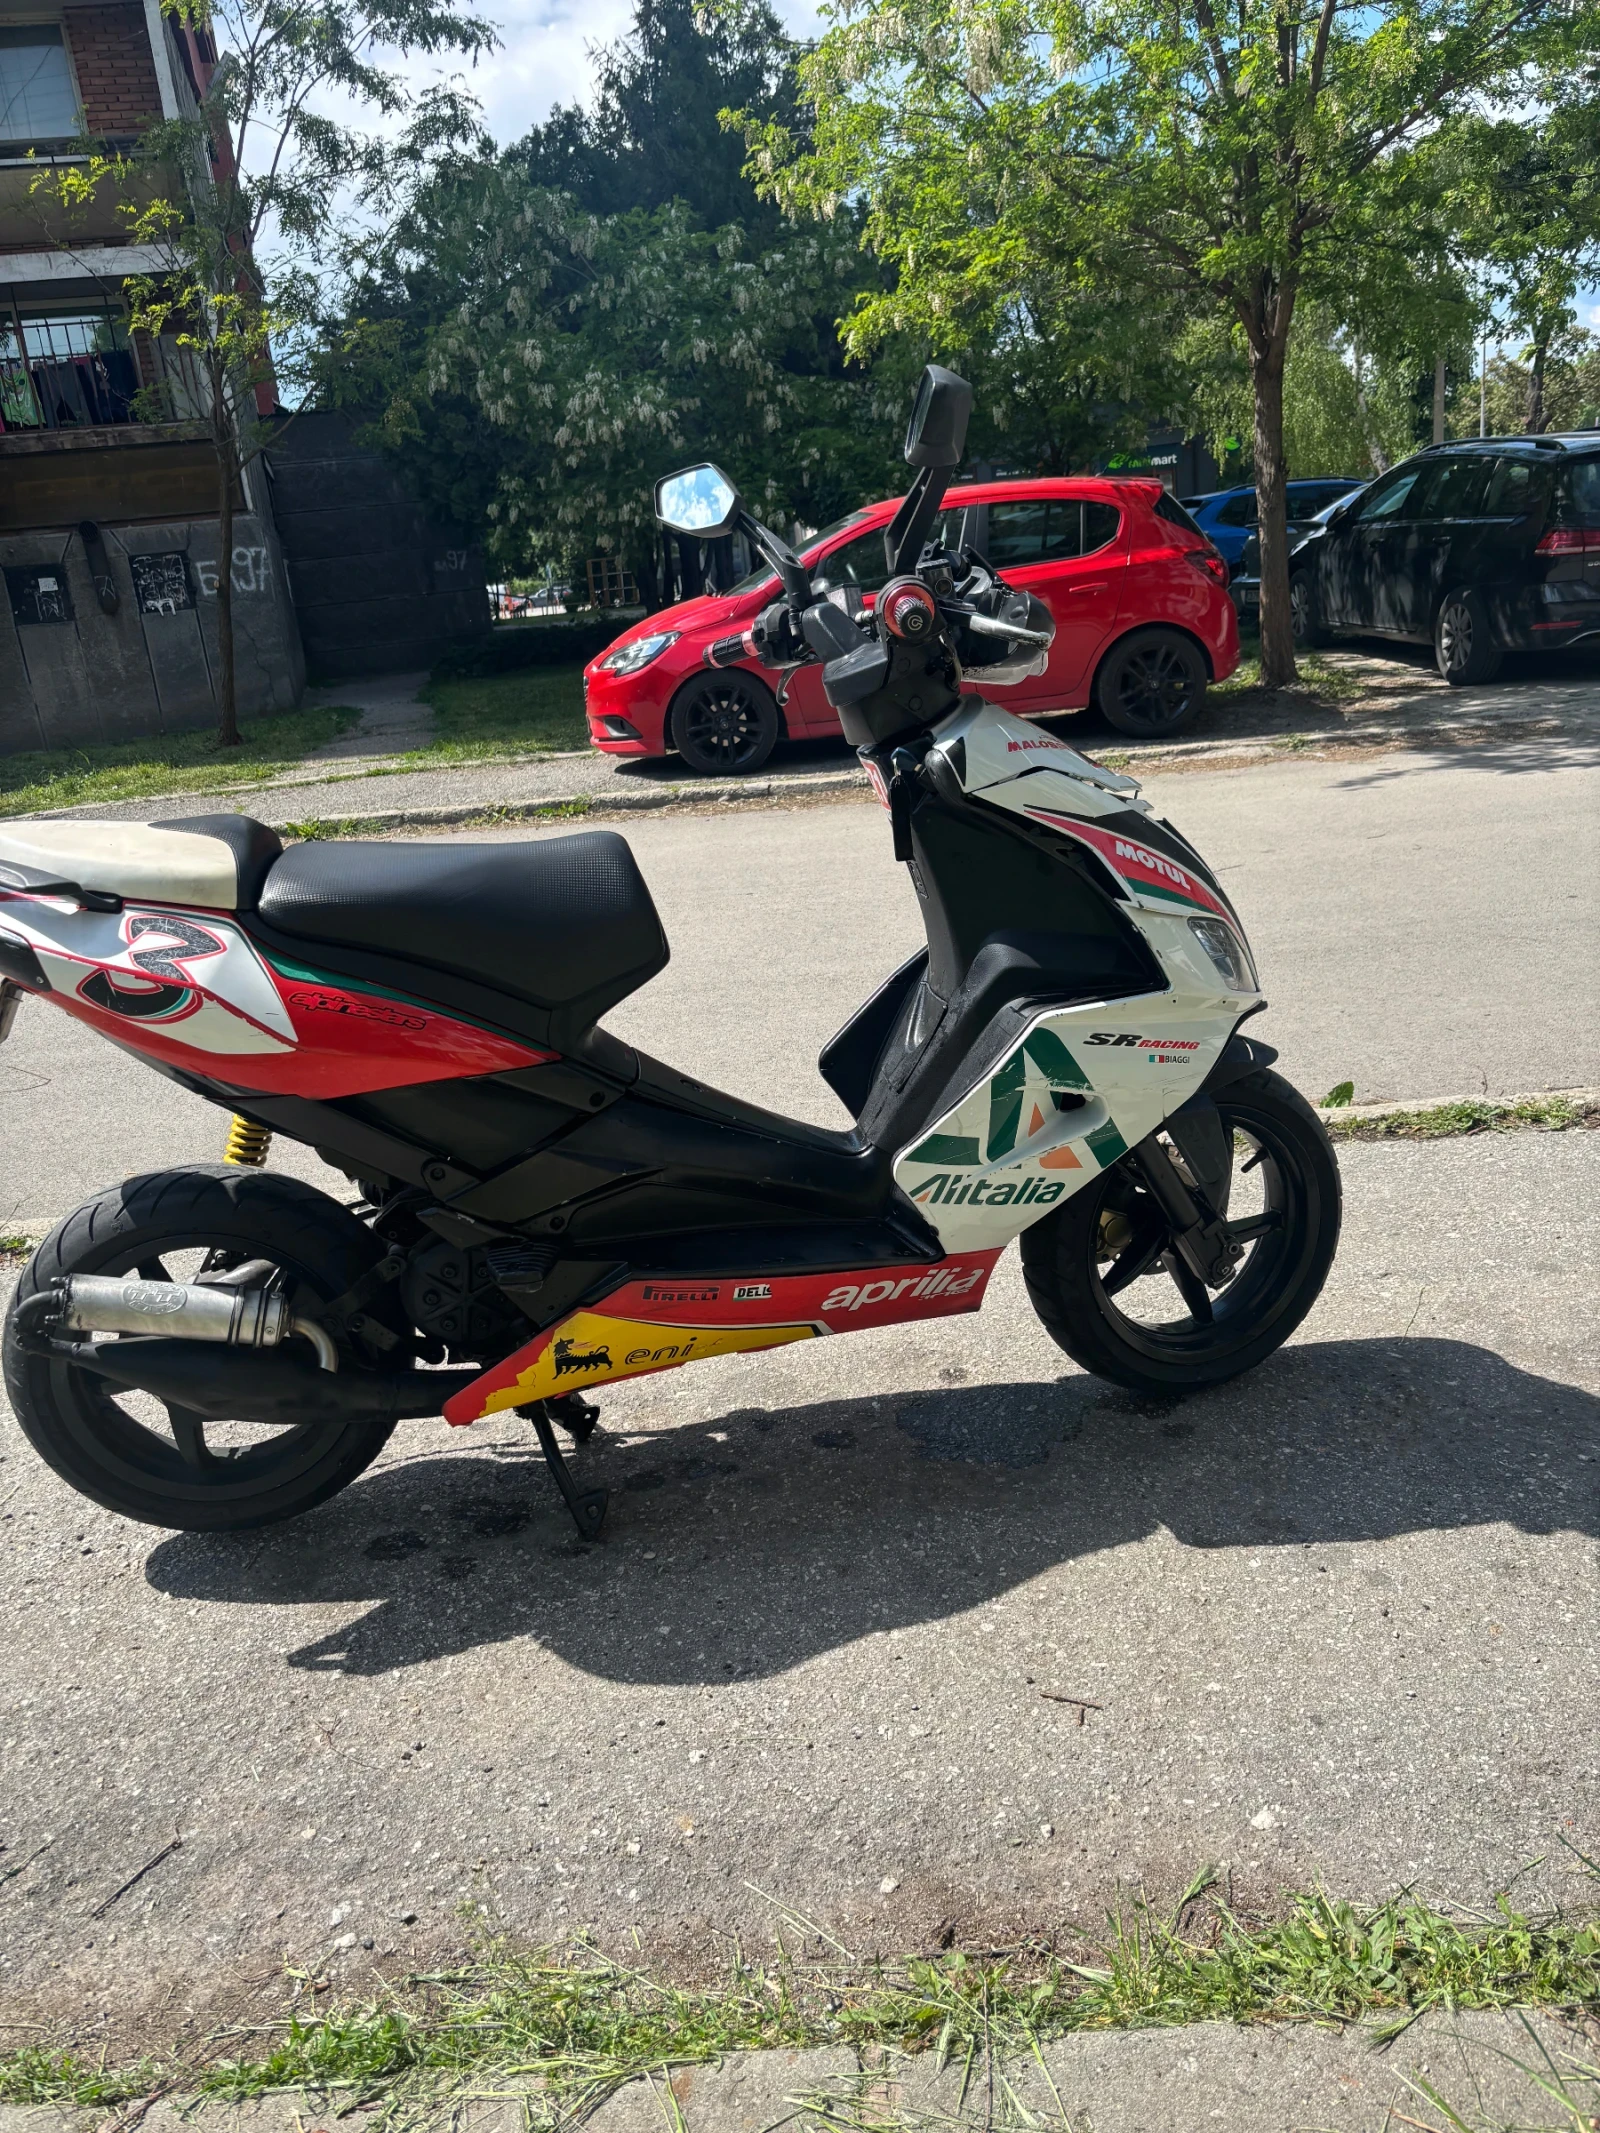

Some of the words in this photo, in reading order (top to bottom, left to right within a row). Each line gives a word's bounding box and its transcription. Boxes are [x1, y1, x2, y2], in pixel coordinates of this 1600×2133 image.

[1115, 840, 1191, 891] MOTUL
[288, 992, 427, 1031] alpinestars
[1083, 1032, 1143, 1047] SR
[1137, 1039, 1201, 1051] RACING
[1164, 1055, 1191, 1064] BIAGGI
[908, 1173, 1066, 1206] Alitalia
[642, 1285, 720, 1302] PIRELLI
[820, 1267, 985, 1312] aprilia
[624, 1336, 698, 1366] eni
